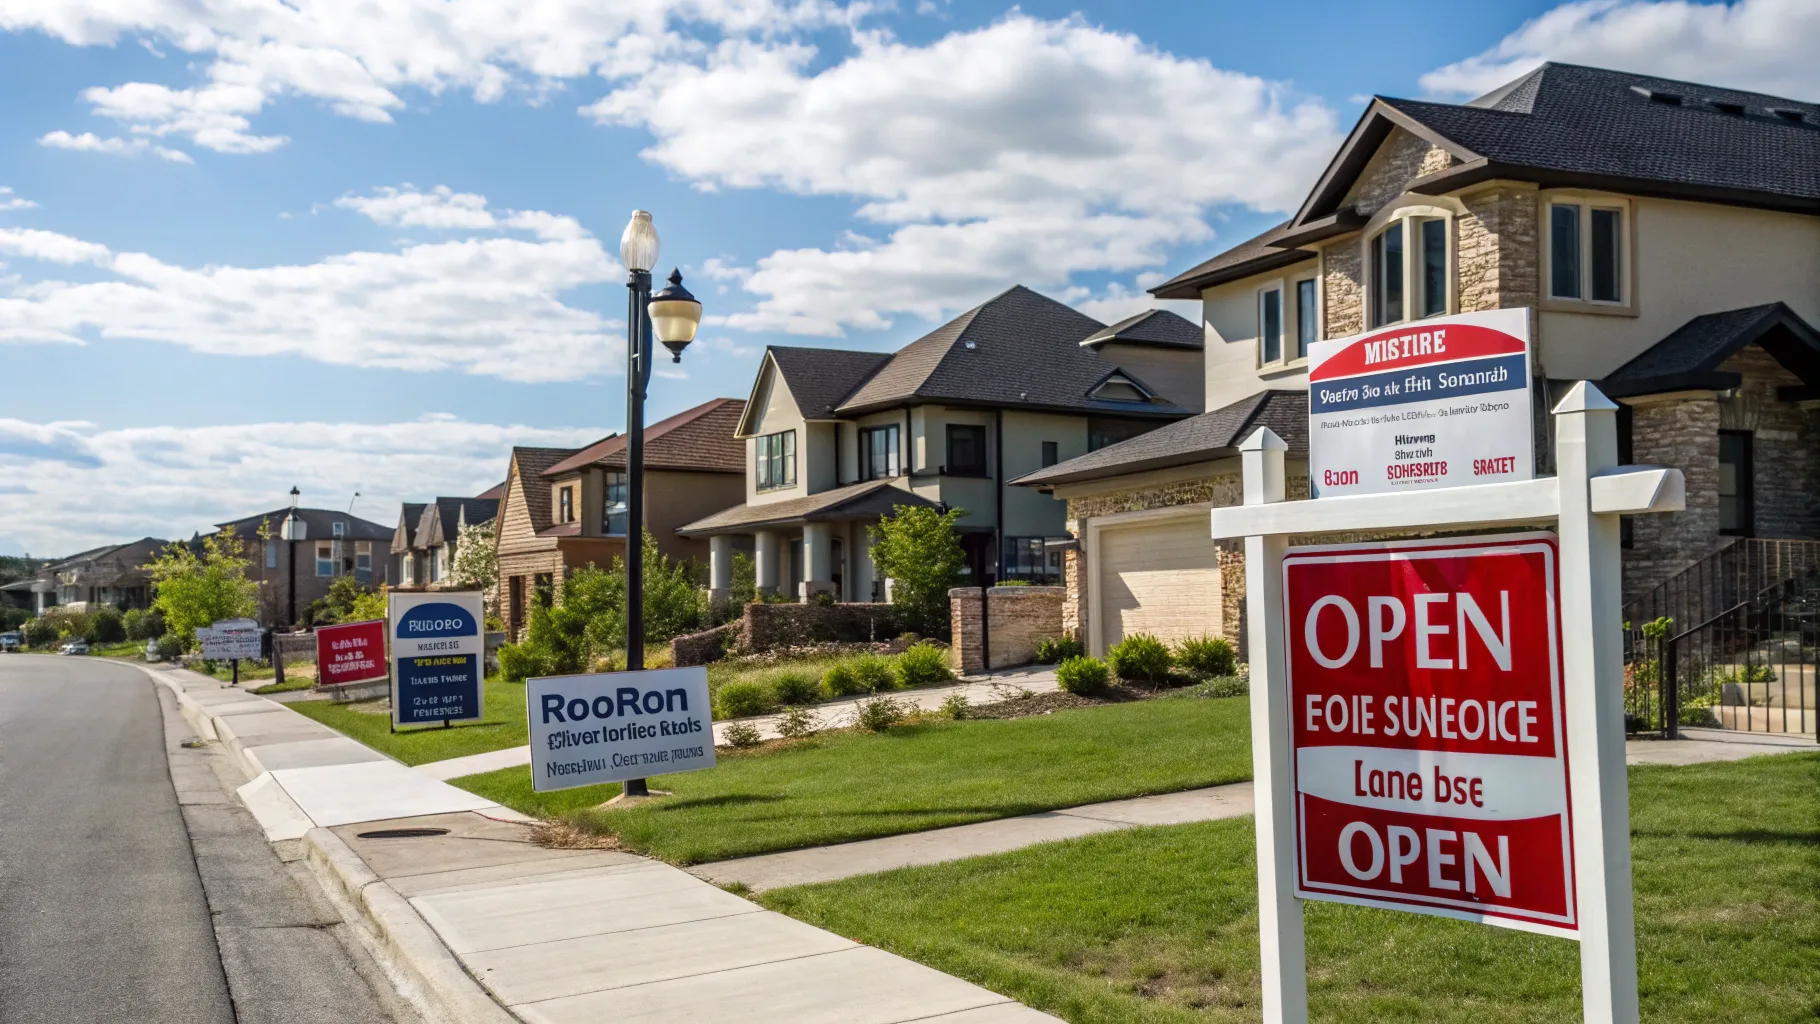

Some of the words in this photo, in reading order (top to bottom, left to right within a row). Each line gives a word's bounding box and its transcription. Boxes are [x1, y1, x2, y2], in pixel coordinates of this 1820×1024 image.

[1304, 590, 1512, 672] OPEN
[541, 687, 689, 724] RooRon
[1306, 694, 1375, 735] EOIE
[1354, 759, 1423, 800] Lane
[1338, 821, 1512, 899] OPEN
